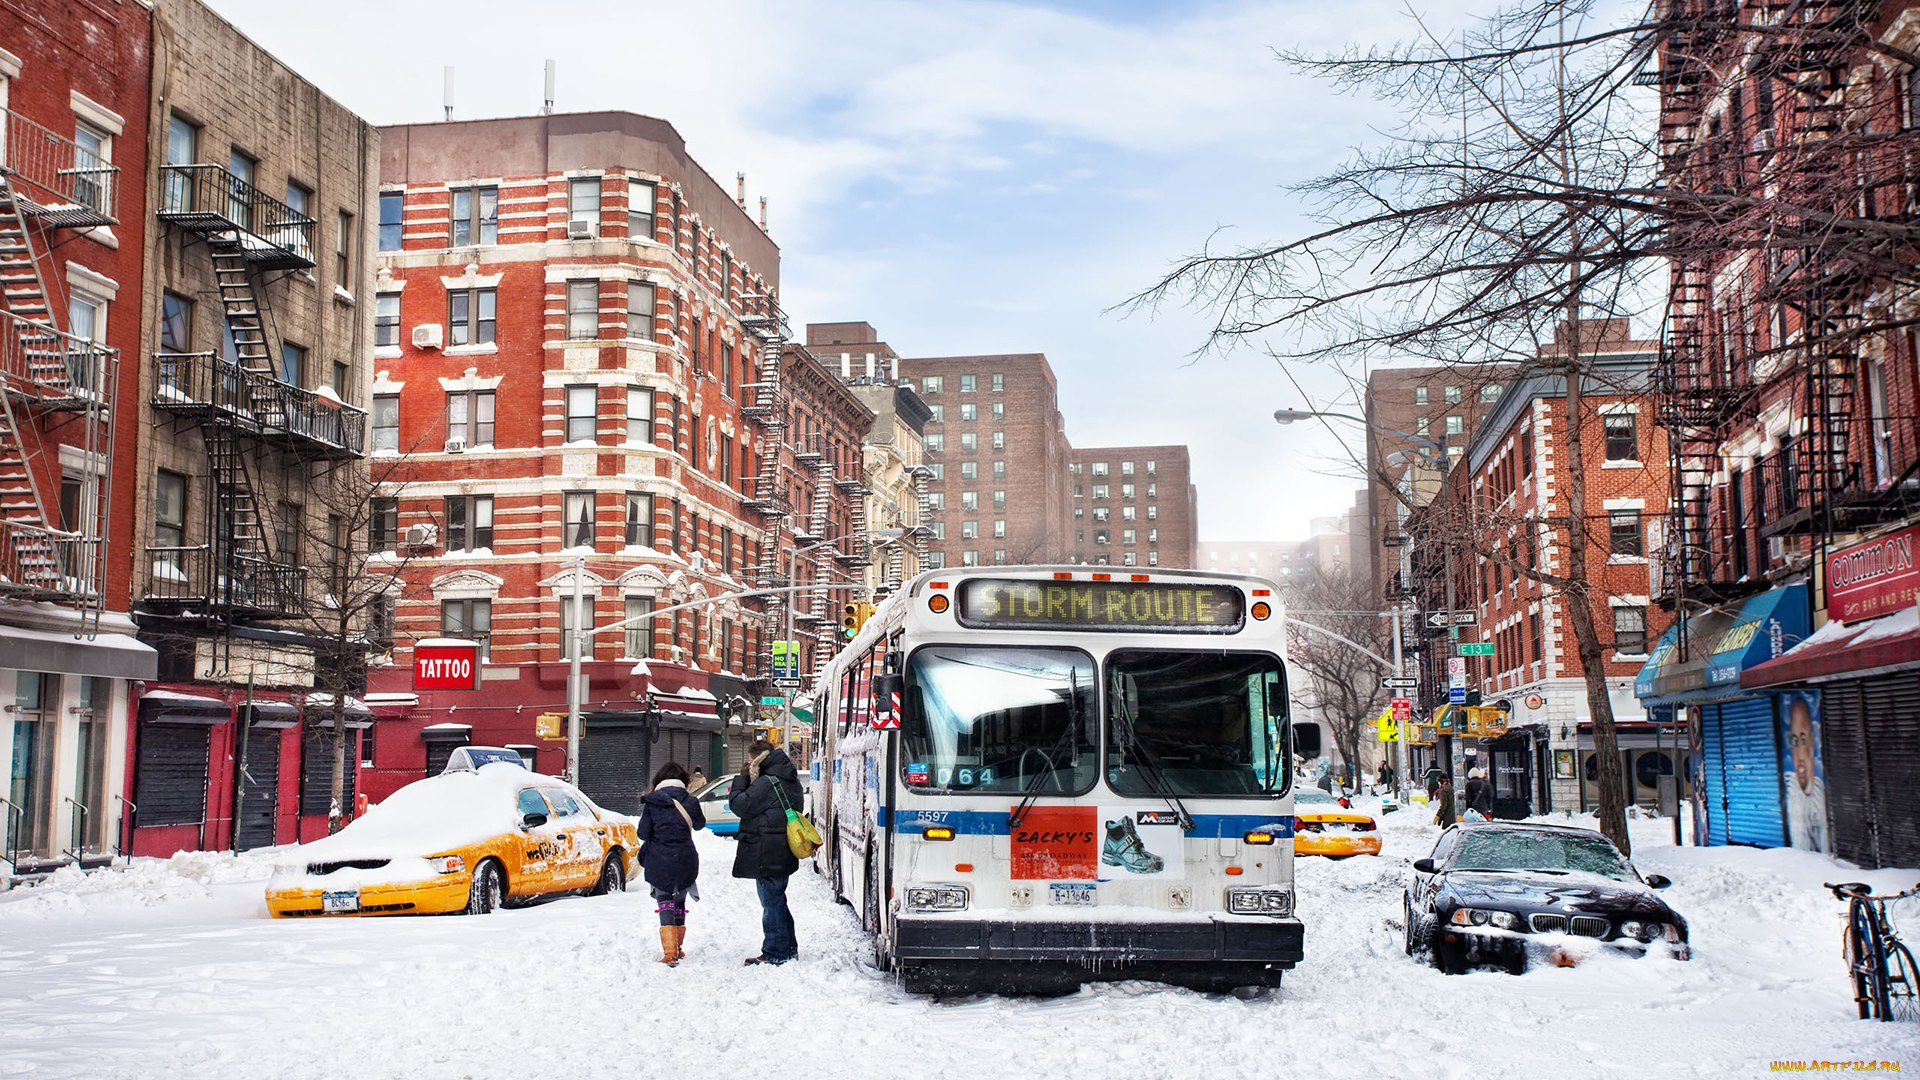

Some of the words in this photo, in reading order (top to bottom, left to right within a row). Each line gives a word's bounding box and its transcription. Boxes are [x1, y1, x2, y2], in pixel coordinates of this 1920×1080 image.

[980, 584, 1093, 619] STORM
[1106, 589, 1214, 622] ROUTE
[1881, 592, 1896, 607] AND
[1461, 645, 1467, 654] E
[1470, 645, 1482, 654] 13
[420, 658, 470, 678] TATTOO
[917, 811, 948, 822] 5597
[1016, 831, 1094, 844] ZACKY'S
